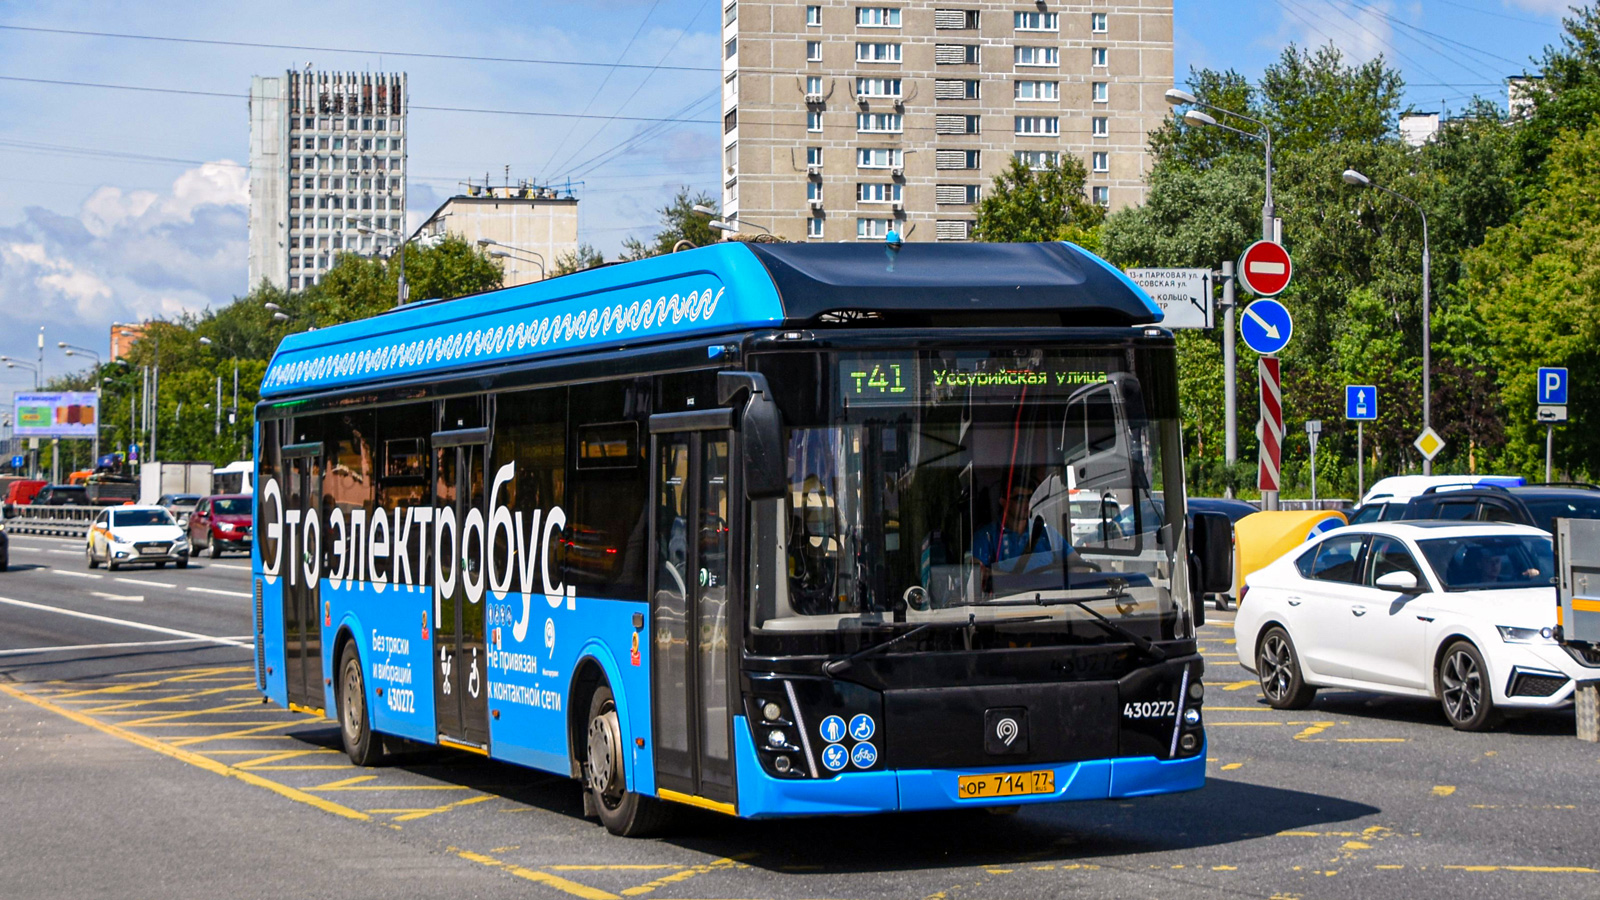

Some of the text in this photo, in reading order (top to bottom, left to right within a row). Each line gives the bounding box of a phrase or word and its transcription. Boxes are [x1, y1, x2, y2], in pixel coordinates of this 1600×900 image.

[1145, 271, 1187, 279] ПАРКОВАЯ
[933, 368, 1108, 386] Уссурийская улица
[1545, 372, 1561, 400] P
[263, 460, 576, 642] Это электробус.
[372, 628, 409, 658] Без тряски
[372, 657, 412, 686] и вибраций
[487, 642, 498, 668] Не
[499, 650, 537, 676] привязан
[388, 687, 415, 714] 430272
[487, 680, 561, 712] к контактной сети
[1123, 700, 1176, 719] 430272
[994, 774, 1024, 794] 714
[1033, 772, 1048, 786] 77
